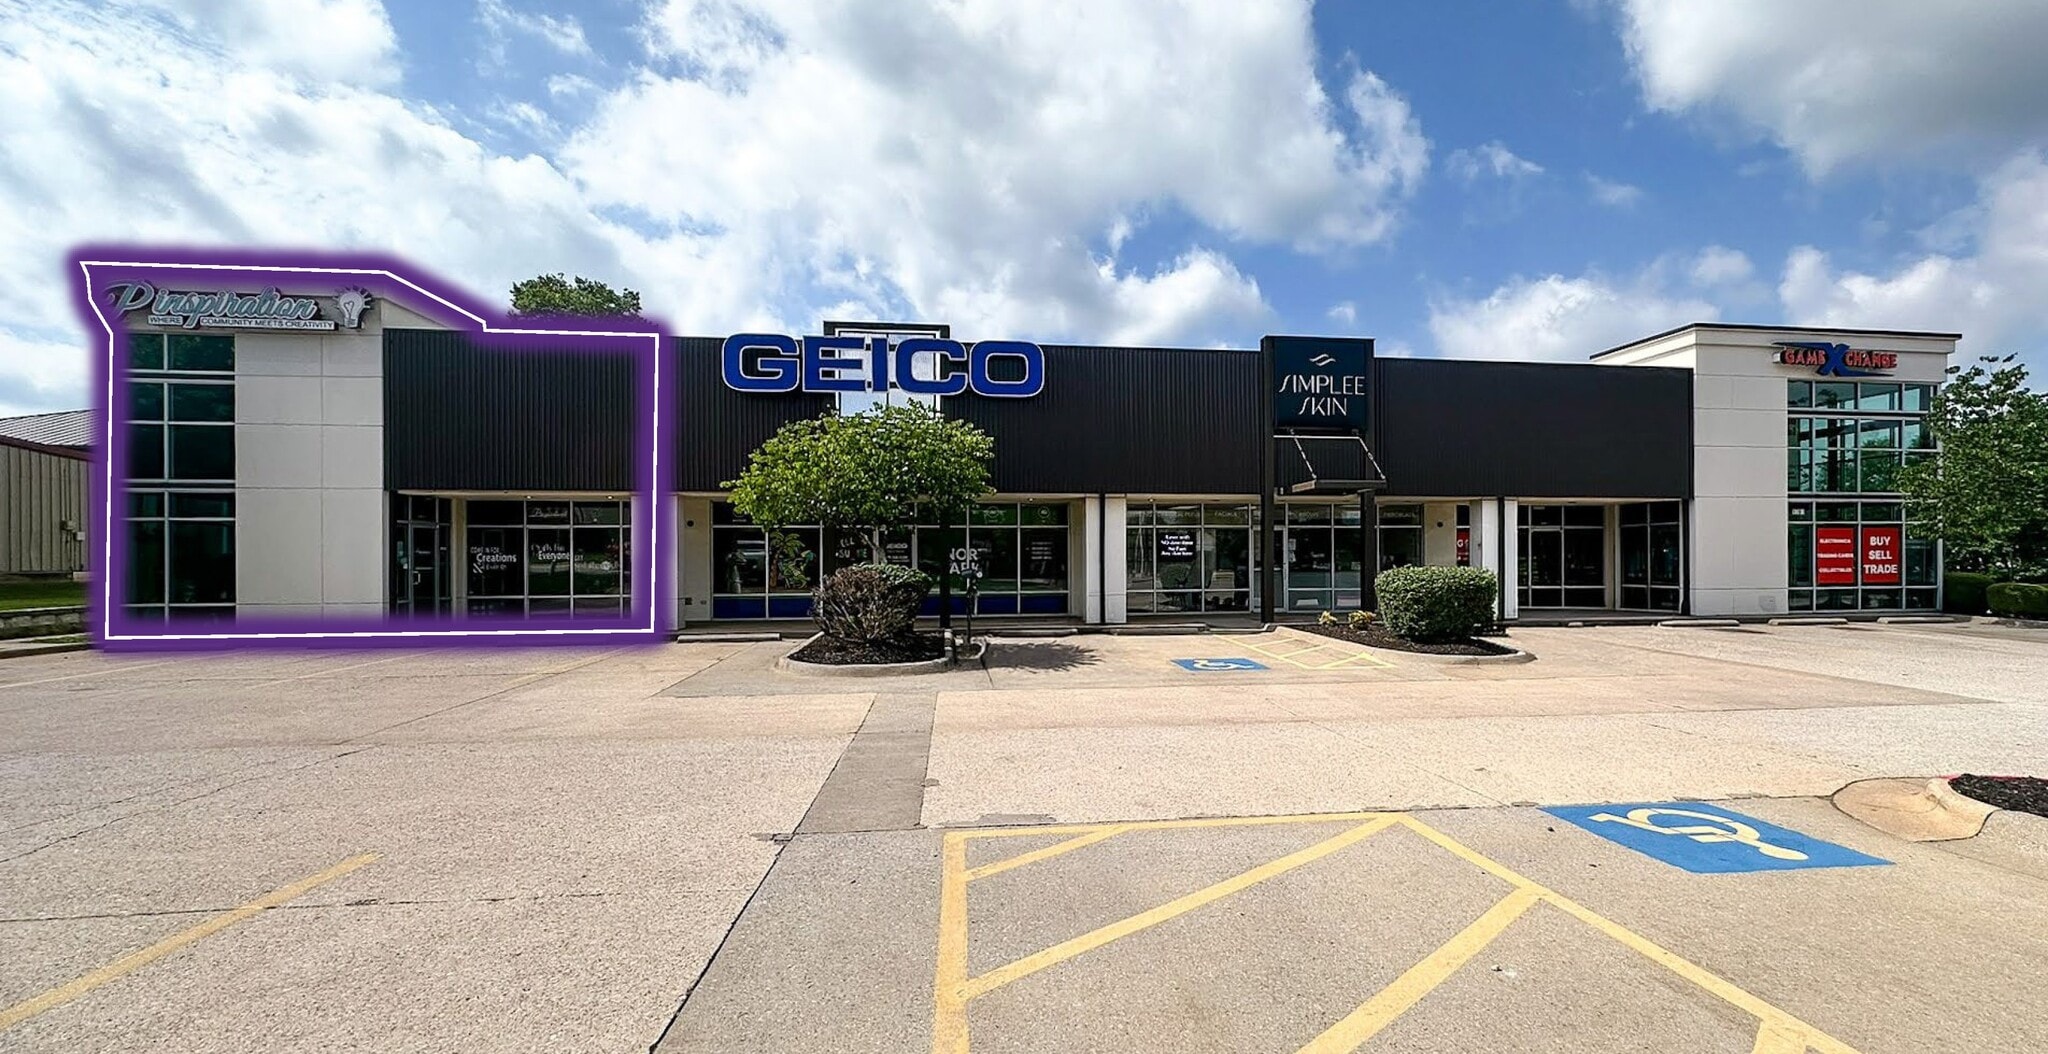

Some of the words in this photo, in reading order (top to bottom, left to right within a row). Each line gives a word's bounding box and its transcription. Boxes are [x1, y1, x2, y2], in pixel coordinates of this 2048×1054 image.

[104, 278, 319, 328] Pinspiration
[149, 316, 182, 325] WHERE
[200, 317, 252, 327] COMMUNITY
[253, 319, 284, 328] MEETS
[285, 320, 333, 330] CREATIVITY
[721, 333, 1045, 398] GEICO
[1278, 374, 1366, 396] SIMPLEE
[1298, 396, 1348, 417] SKIN
[1869, 535, 1891, 546] BUY
[475, 552, 518, 563] Creations
[1867, 549, 1893, 560] SELL
[1863, 563, 1898, 574] TRADE
